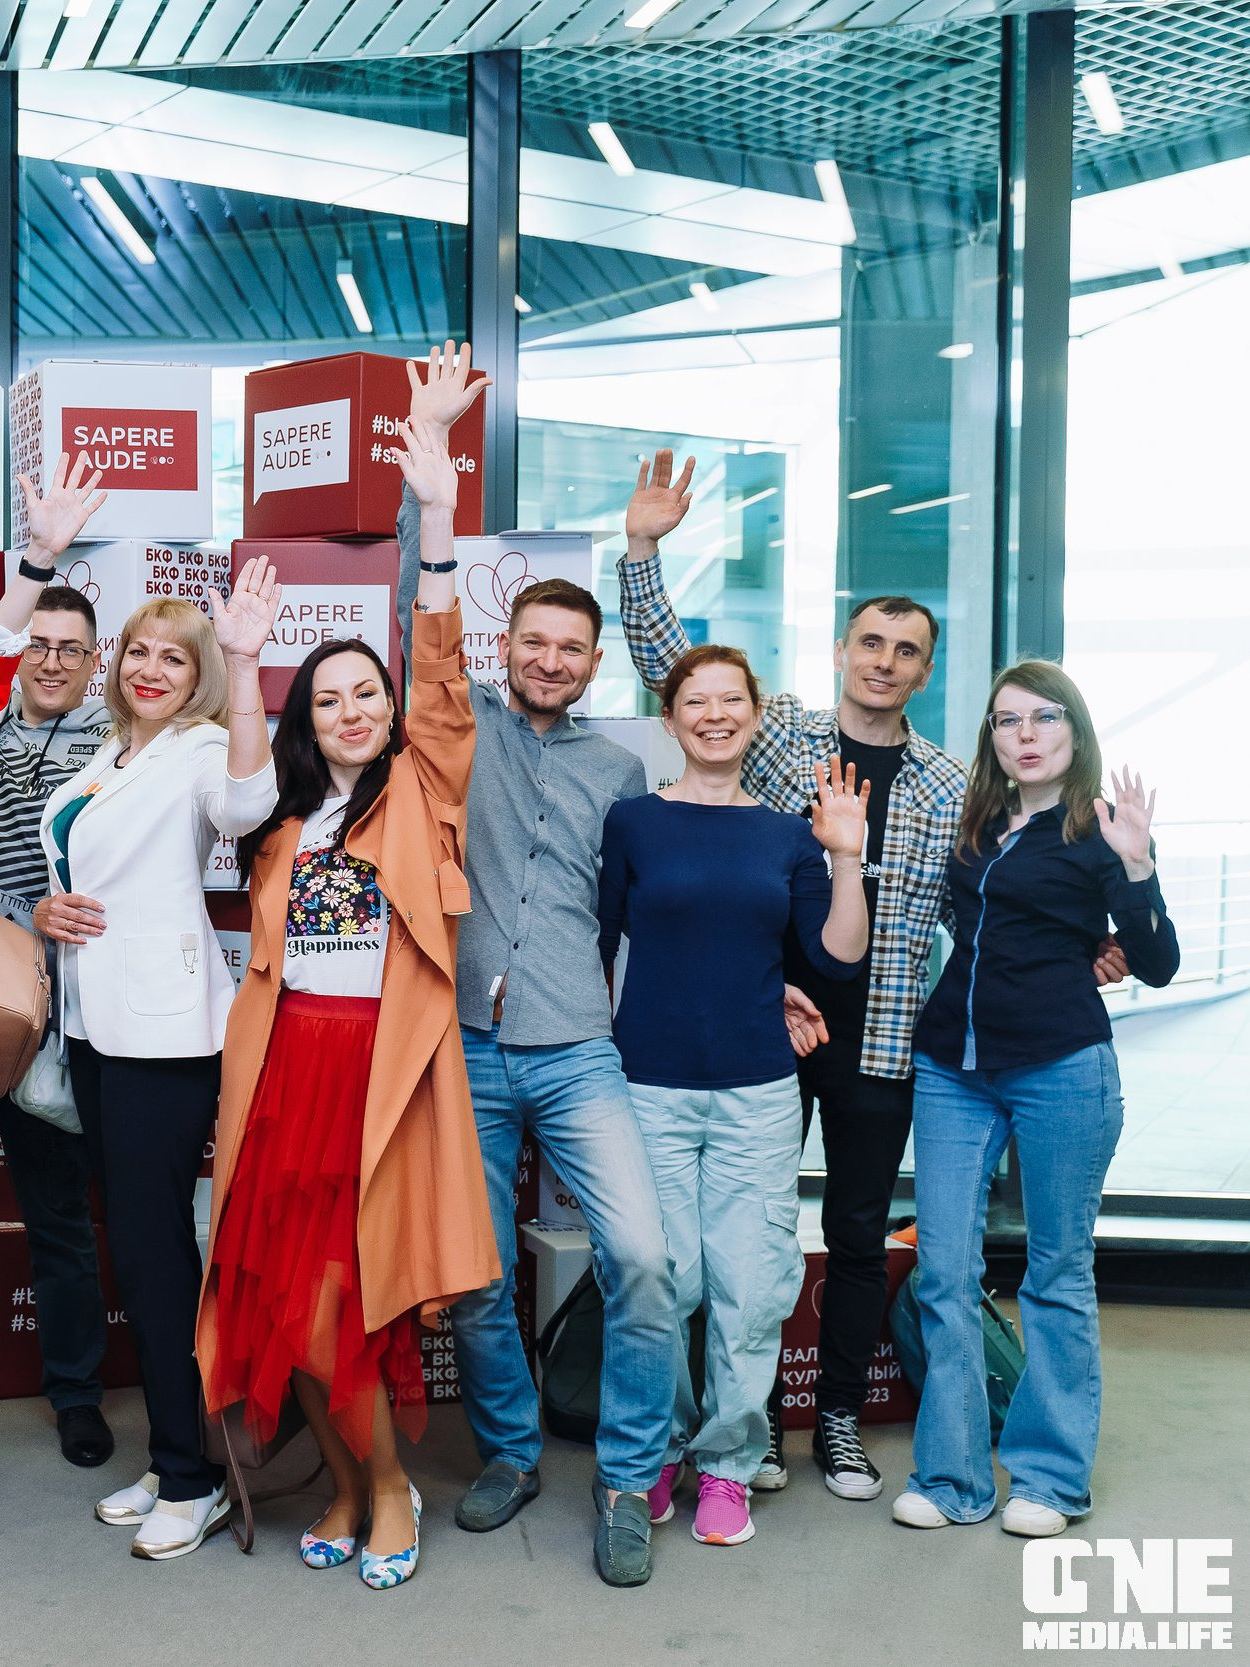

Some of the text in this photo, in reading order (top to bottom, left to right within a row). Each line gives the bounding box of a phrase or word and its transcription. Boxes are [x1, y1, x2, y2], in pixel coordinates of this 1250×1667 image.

[74, 426, 174, 447] SAPERE
[262, 421, 332, 448] SAPERE
[262, 448, 312, 472] AUDE
[146, 548, 229, 568] БКФ БКФ БКФ
[153, 566, 179, 580] БКФ
[185, 568, 208, 582] БКФ
[146, 581, 203, 597] БКФ БКФ
[278, 604, 364, 622] APERE
[287, 937, 380, 958] Happiness
[422, 1366, 459, 1381] БКФ
